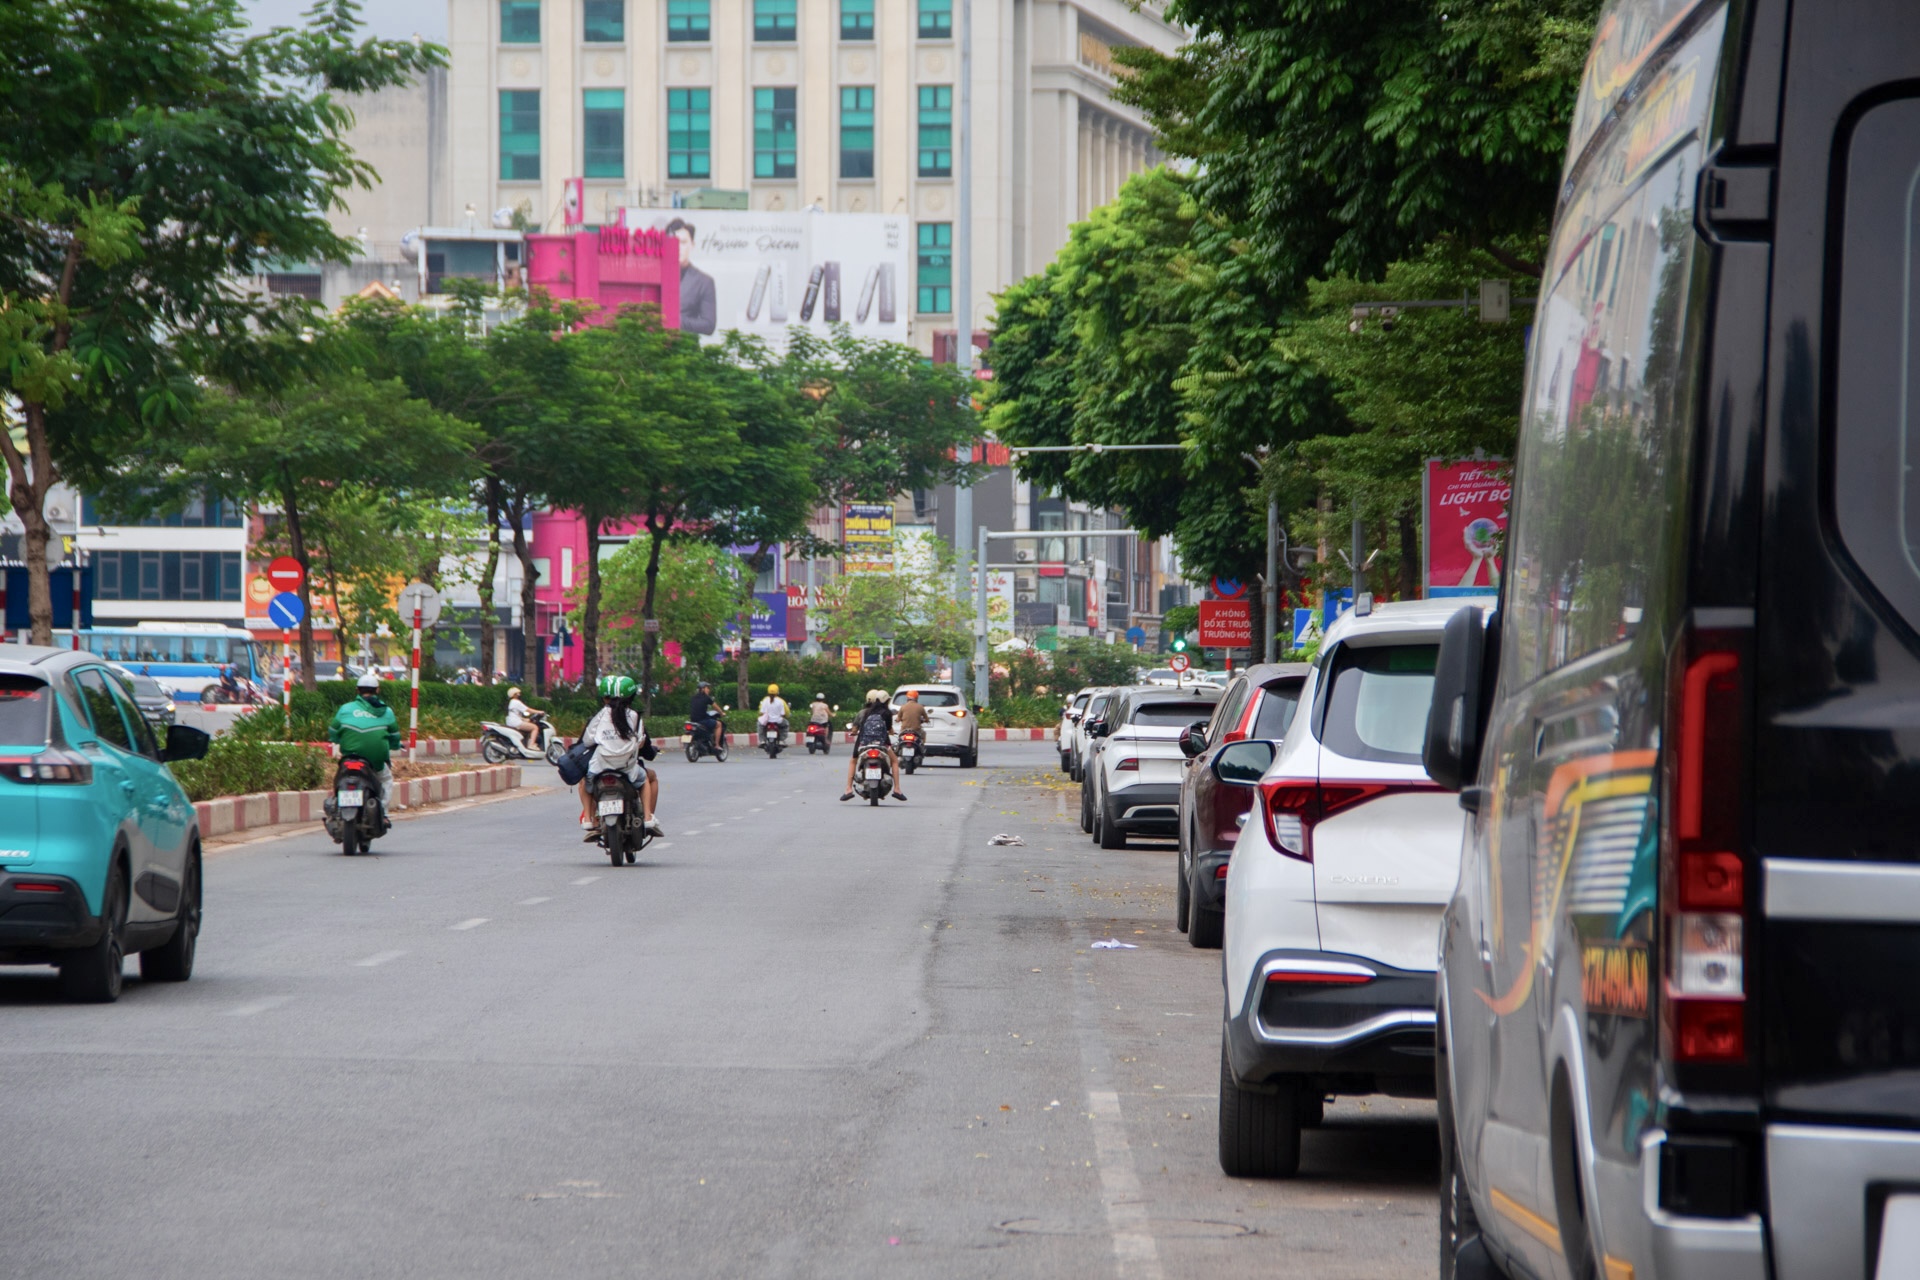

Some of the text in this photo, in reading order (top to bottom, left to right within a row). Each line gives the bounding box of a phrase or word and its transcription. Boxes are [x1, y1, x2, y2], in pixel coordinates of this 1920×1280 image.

[1459, 467, 1484, 481] TIẾT
[1439, 488, 1512, 506] LIGHT BO
[1215, 608, 1246, 618] KHÔNG
[1216, 620, 1226, 628] XE
[1228, 618, 1251, 628] TRƯỚ
